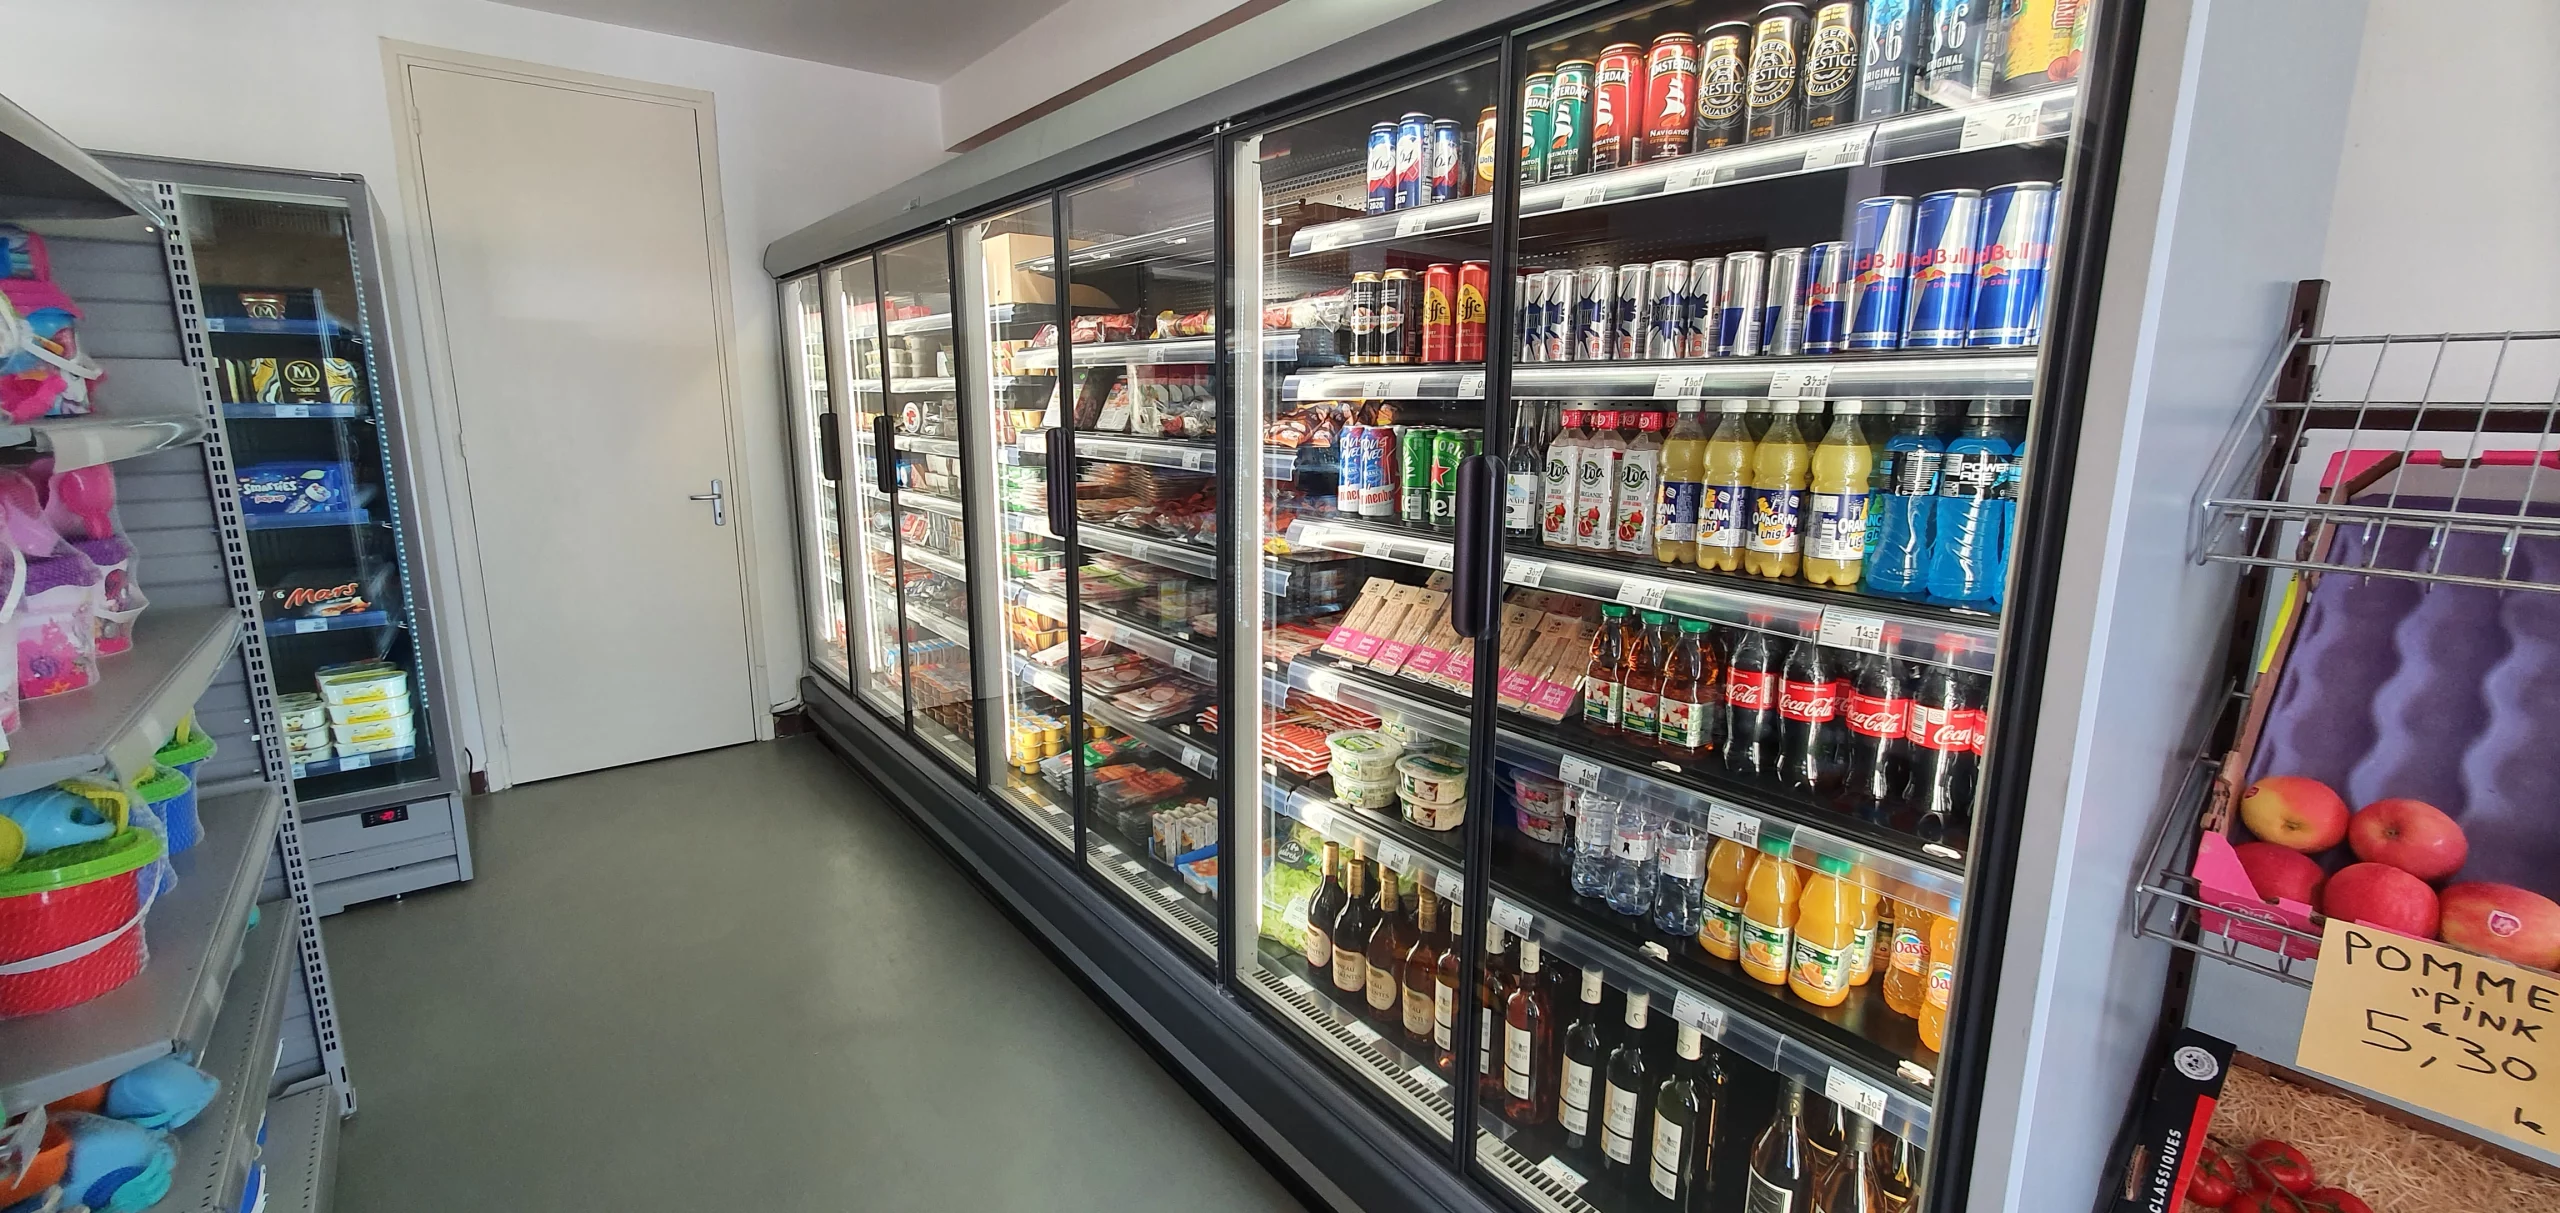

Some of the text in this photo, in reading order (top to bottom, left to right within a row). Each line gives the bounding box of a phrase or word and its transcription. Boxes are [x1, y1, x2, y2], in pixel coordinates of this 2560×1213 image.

[1895, 940, 1931, 955] Oasis
[2345, 930, 2560, 1014] POMME
[2149, 1128, 2182, 1213] CLASSIQUES
